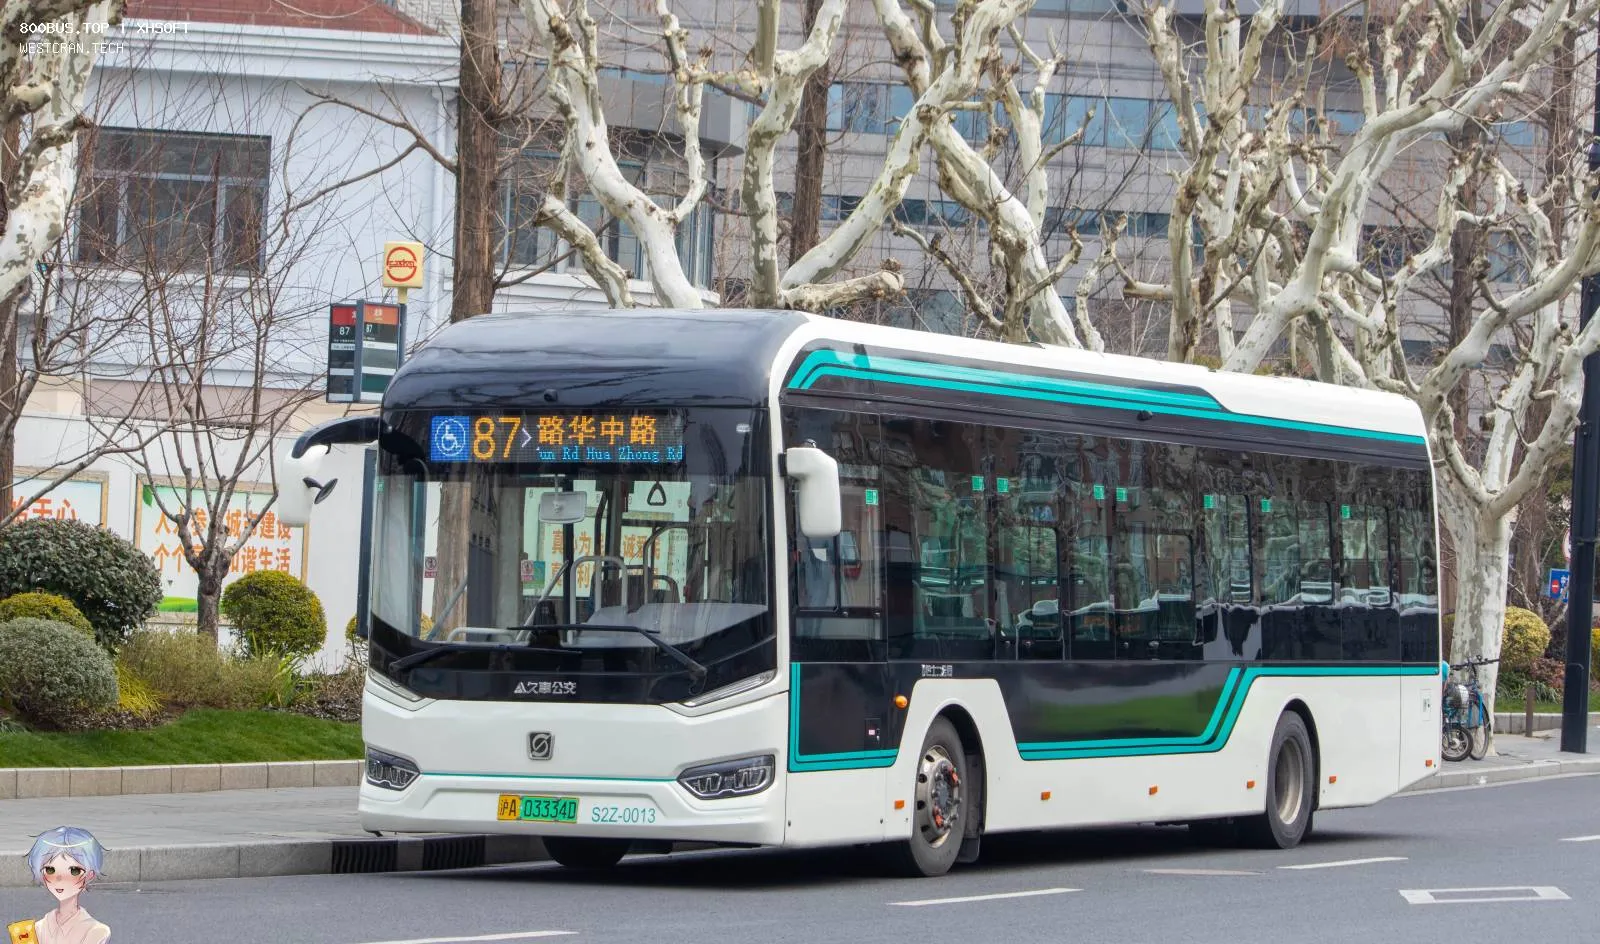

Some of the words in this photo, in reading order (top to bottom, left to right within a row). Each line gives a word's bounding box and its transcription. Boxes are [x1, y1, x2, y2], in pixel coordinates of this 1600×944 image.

[339, 326, 351, 336] 87
[473, 416, 521, 460] 87
[538, 415, 658, 445] 路华中路
[562, 445, 580, 460] Rd
[586, 446, 611, 460] Hua
[618, 445, 660, 463] Zhong
[666, 445, 684, 460] Rd
[154, 507, 292, 540] 人参城市建设
[153, 542, 292, 575] 个个谐生活
[591, 806, 656, 824] S2Z-0013
